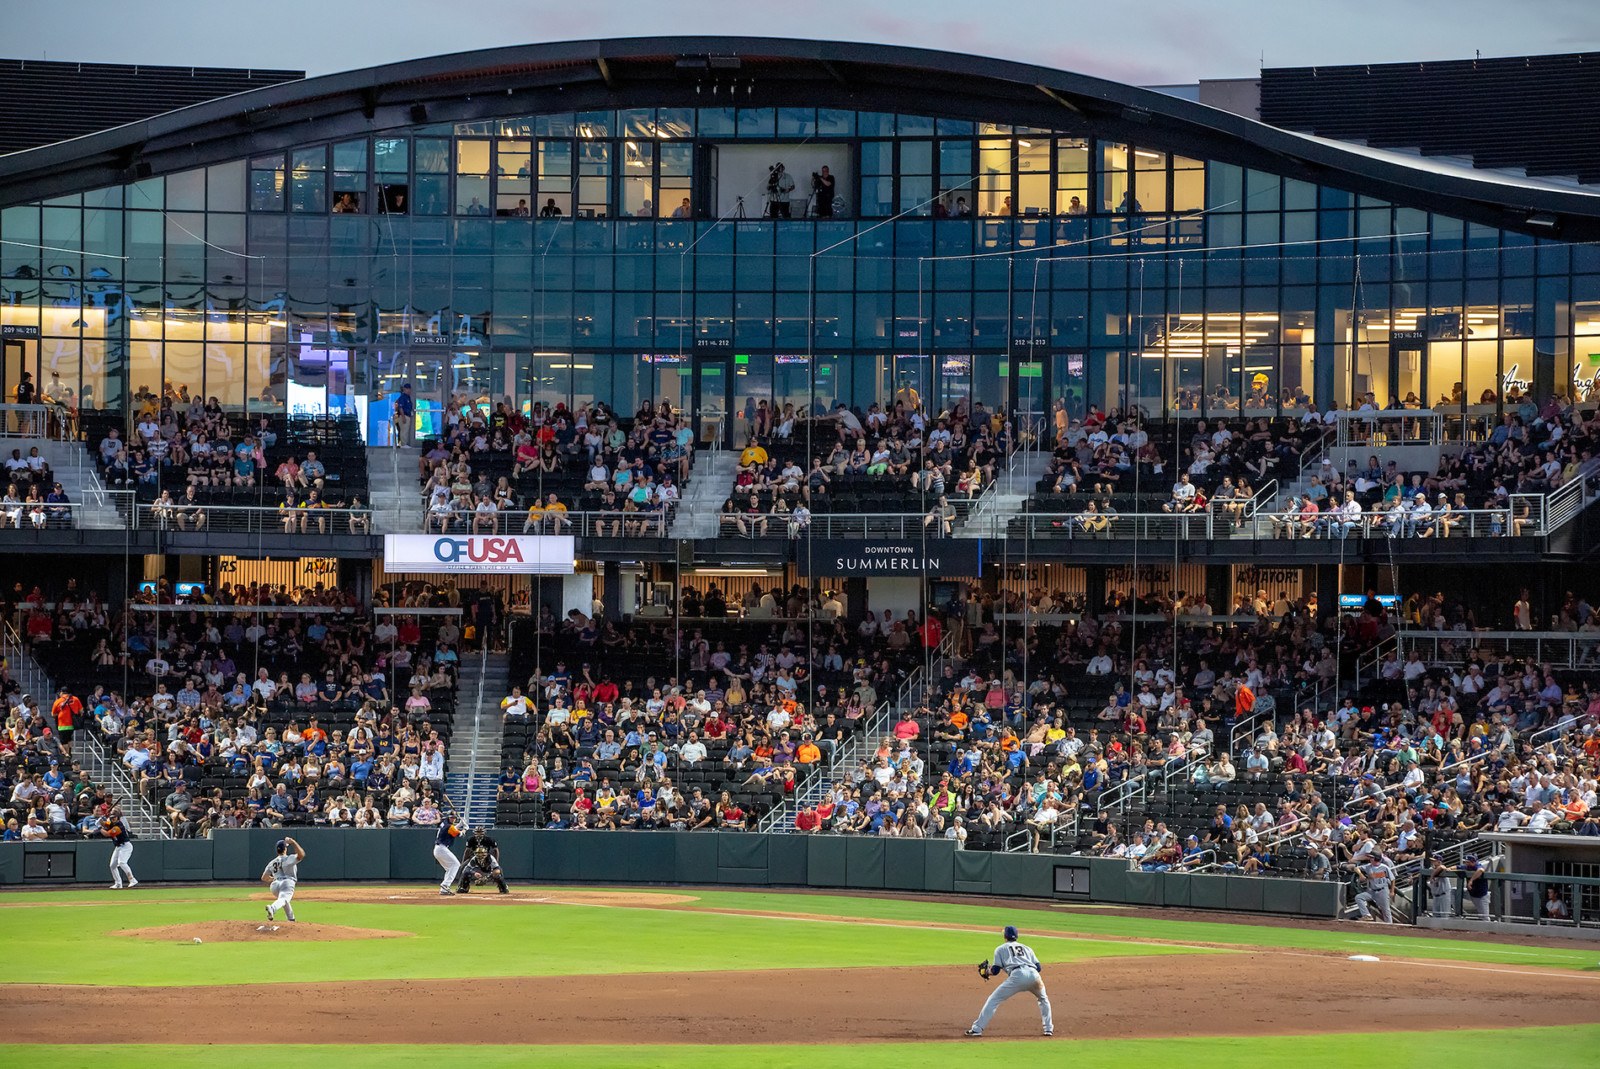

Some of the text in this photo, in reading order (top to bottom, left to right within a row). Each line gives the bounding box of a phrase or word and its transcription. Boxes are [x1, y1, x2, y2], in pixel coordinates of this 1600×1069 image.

[434, 537, 525, 563] OFUSA
[865, 546, 914, 554] DOWNTOWN
[836, 557, 940, 570] SUMMERLIN
[1008, 945, 1026, 958] 13
